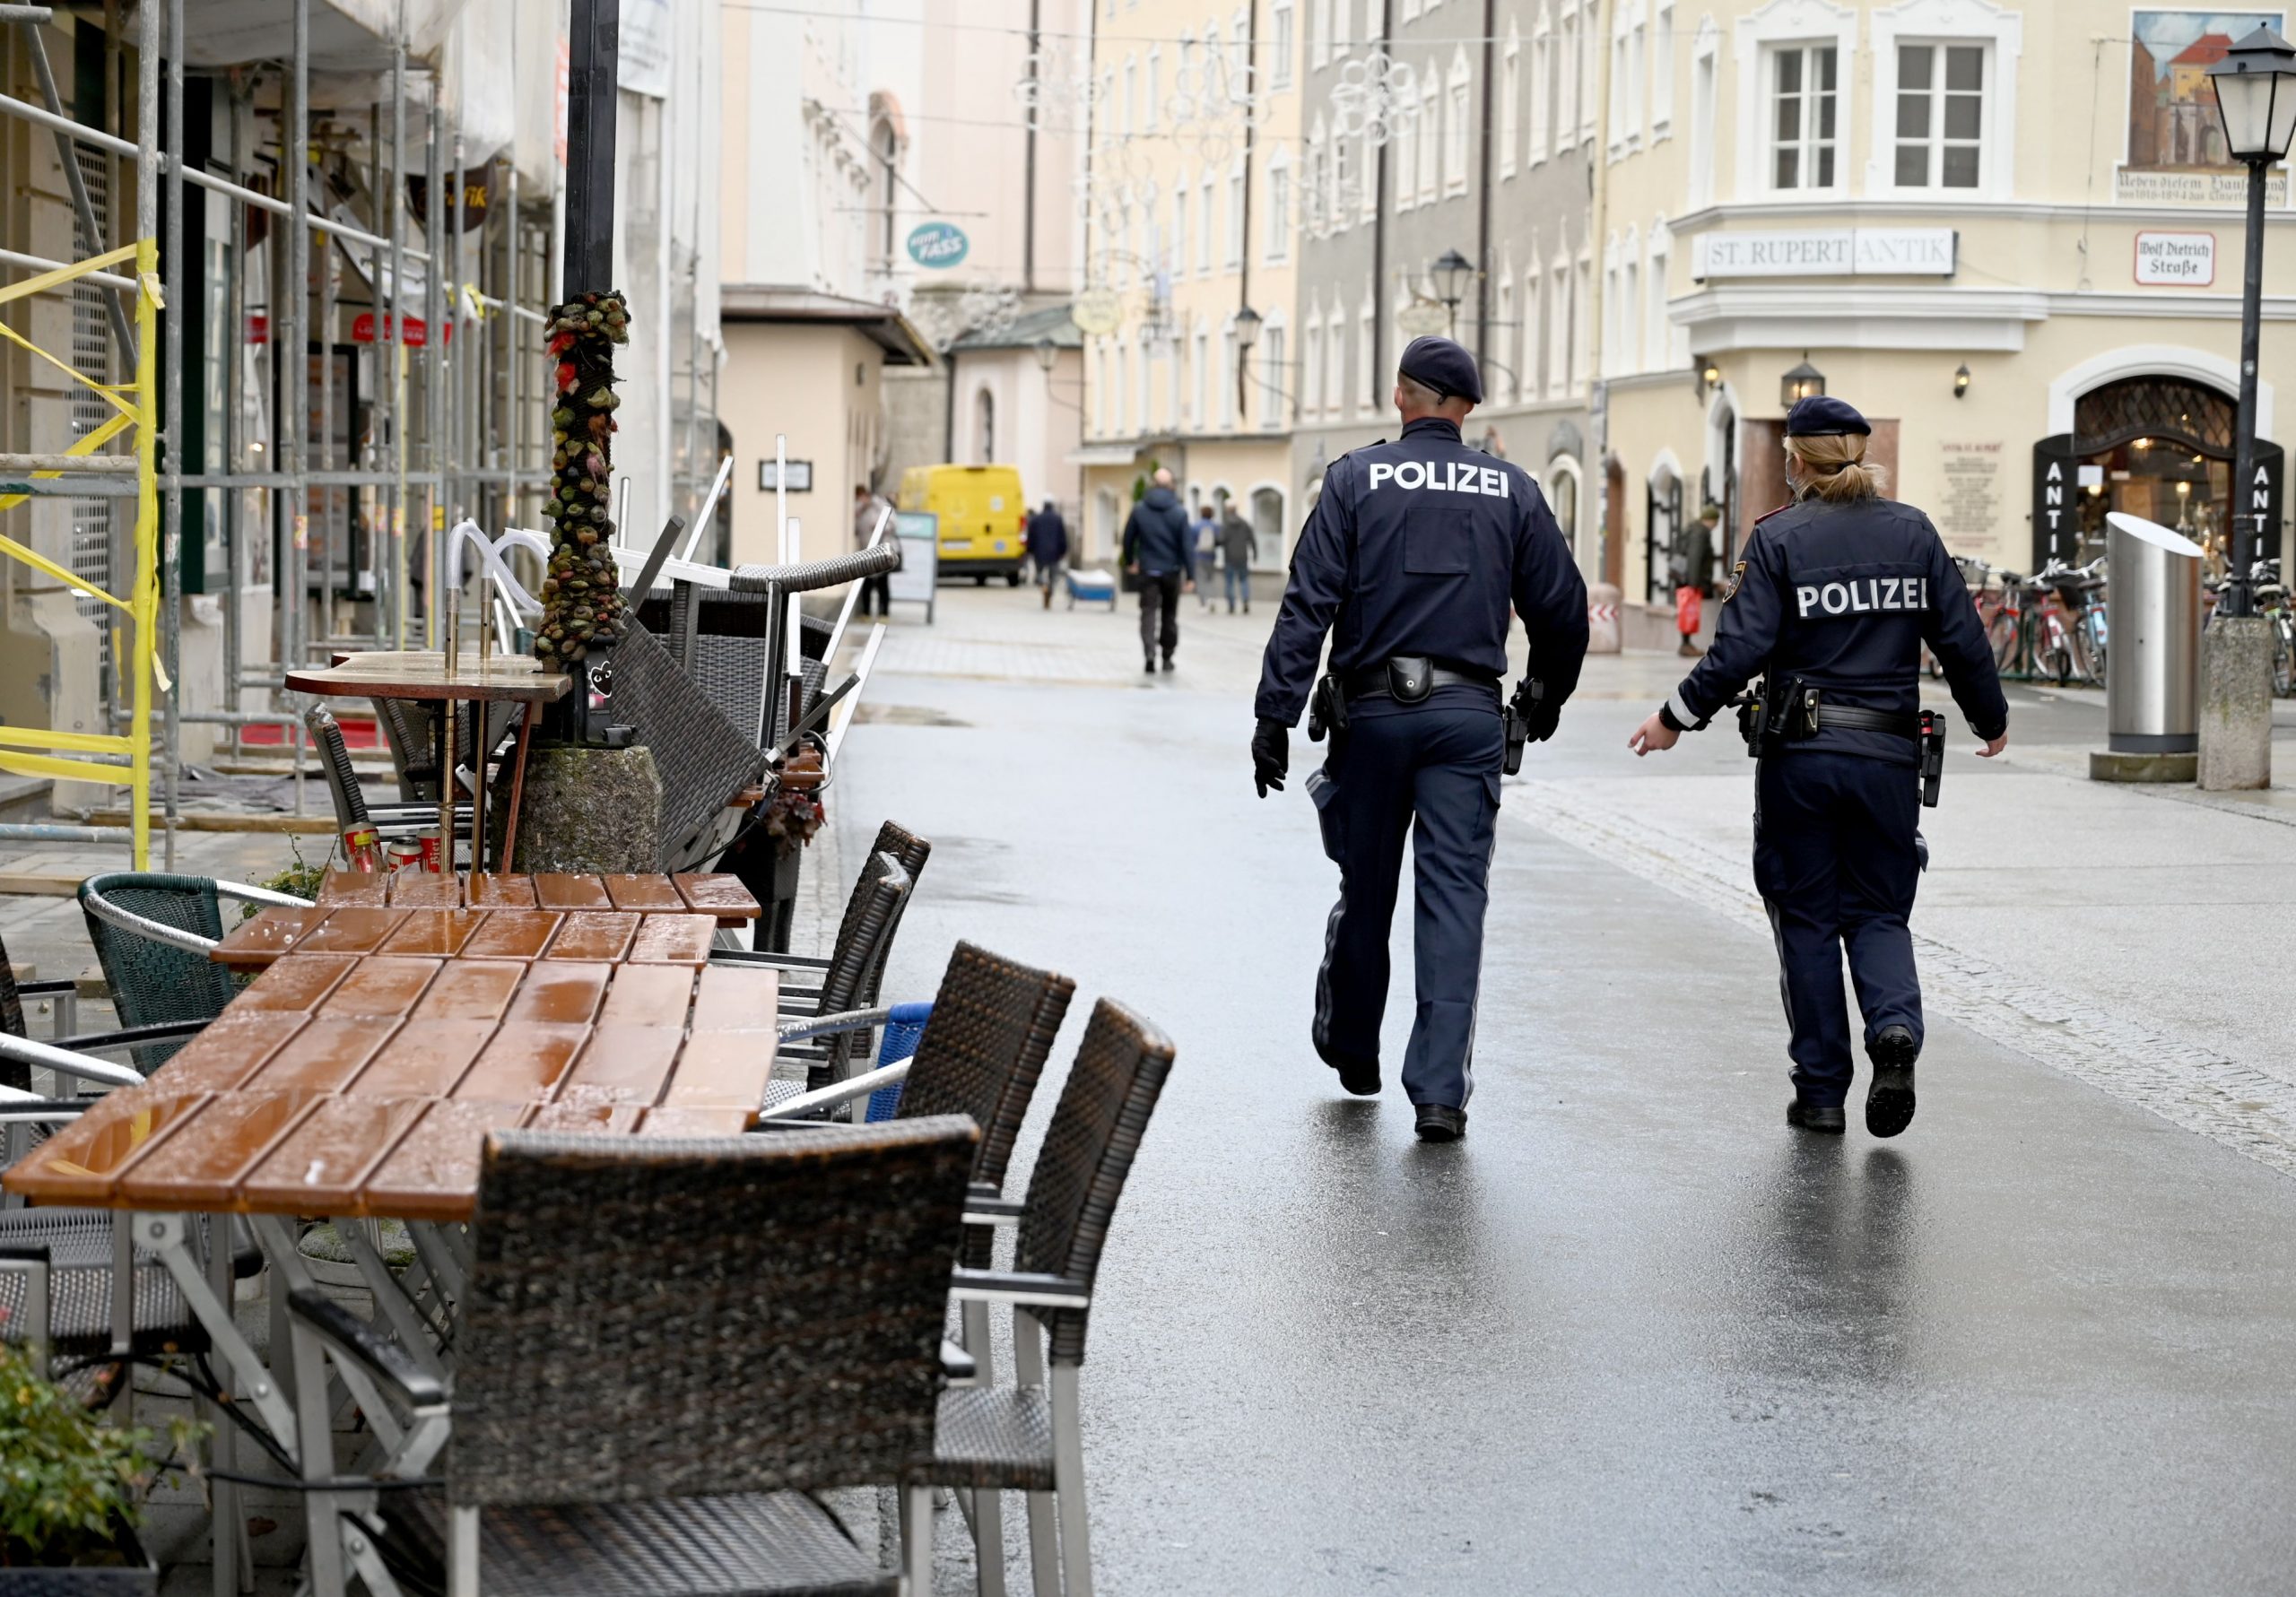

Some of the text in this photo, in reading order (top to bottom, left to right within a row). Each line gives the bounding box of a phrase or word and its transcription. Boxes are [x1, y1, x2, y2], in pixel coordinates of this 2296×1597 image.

[918, 237, 962, 260] FASS
[1710, 237, 1946, 265] ST. RUPERT ANTIK
[2139, 241, 2209, 257] Wolf Dietrich
[2150, 257, 2198, 276] Straße
[1370, 461, 1509, 499] POLIZEI
[2046, 461, 2062, 577] ANTIK
[1796, 577, 1928, 617] POLIZEI
